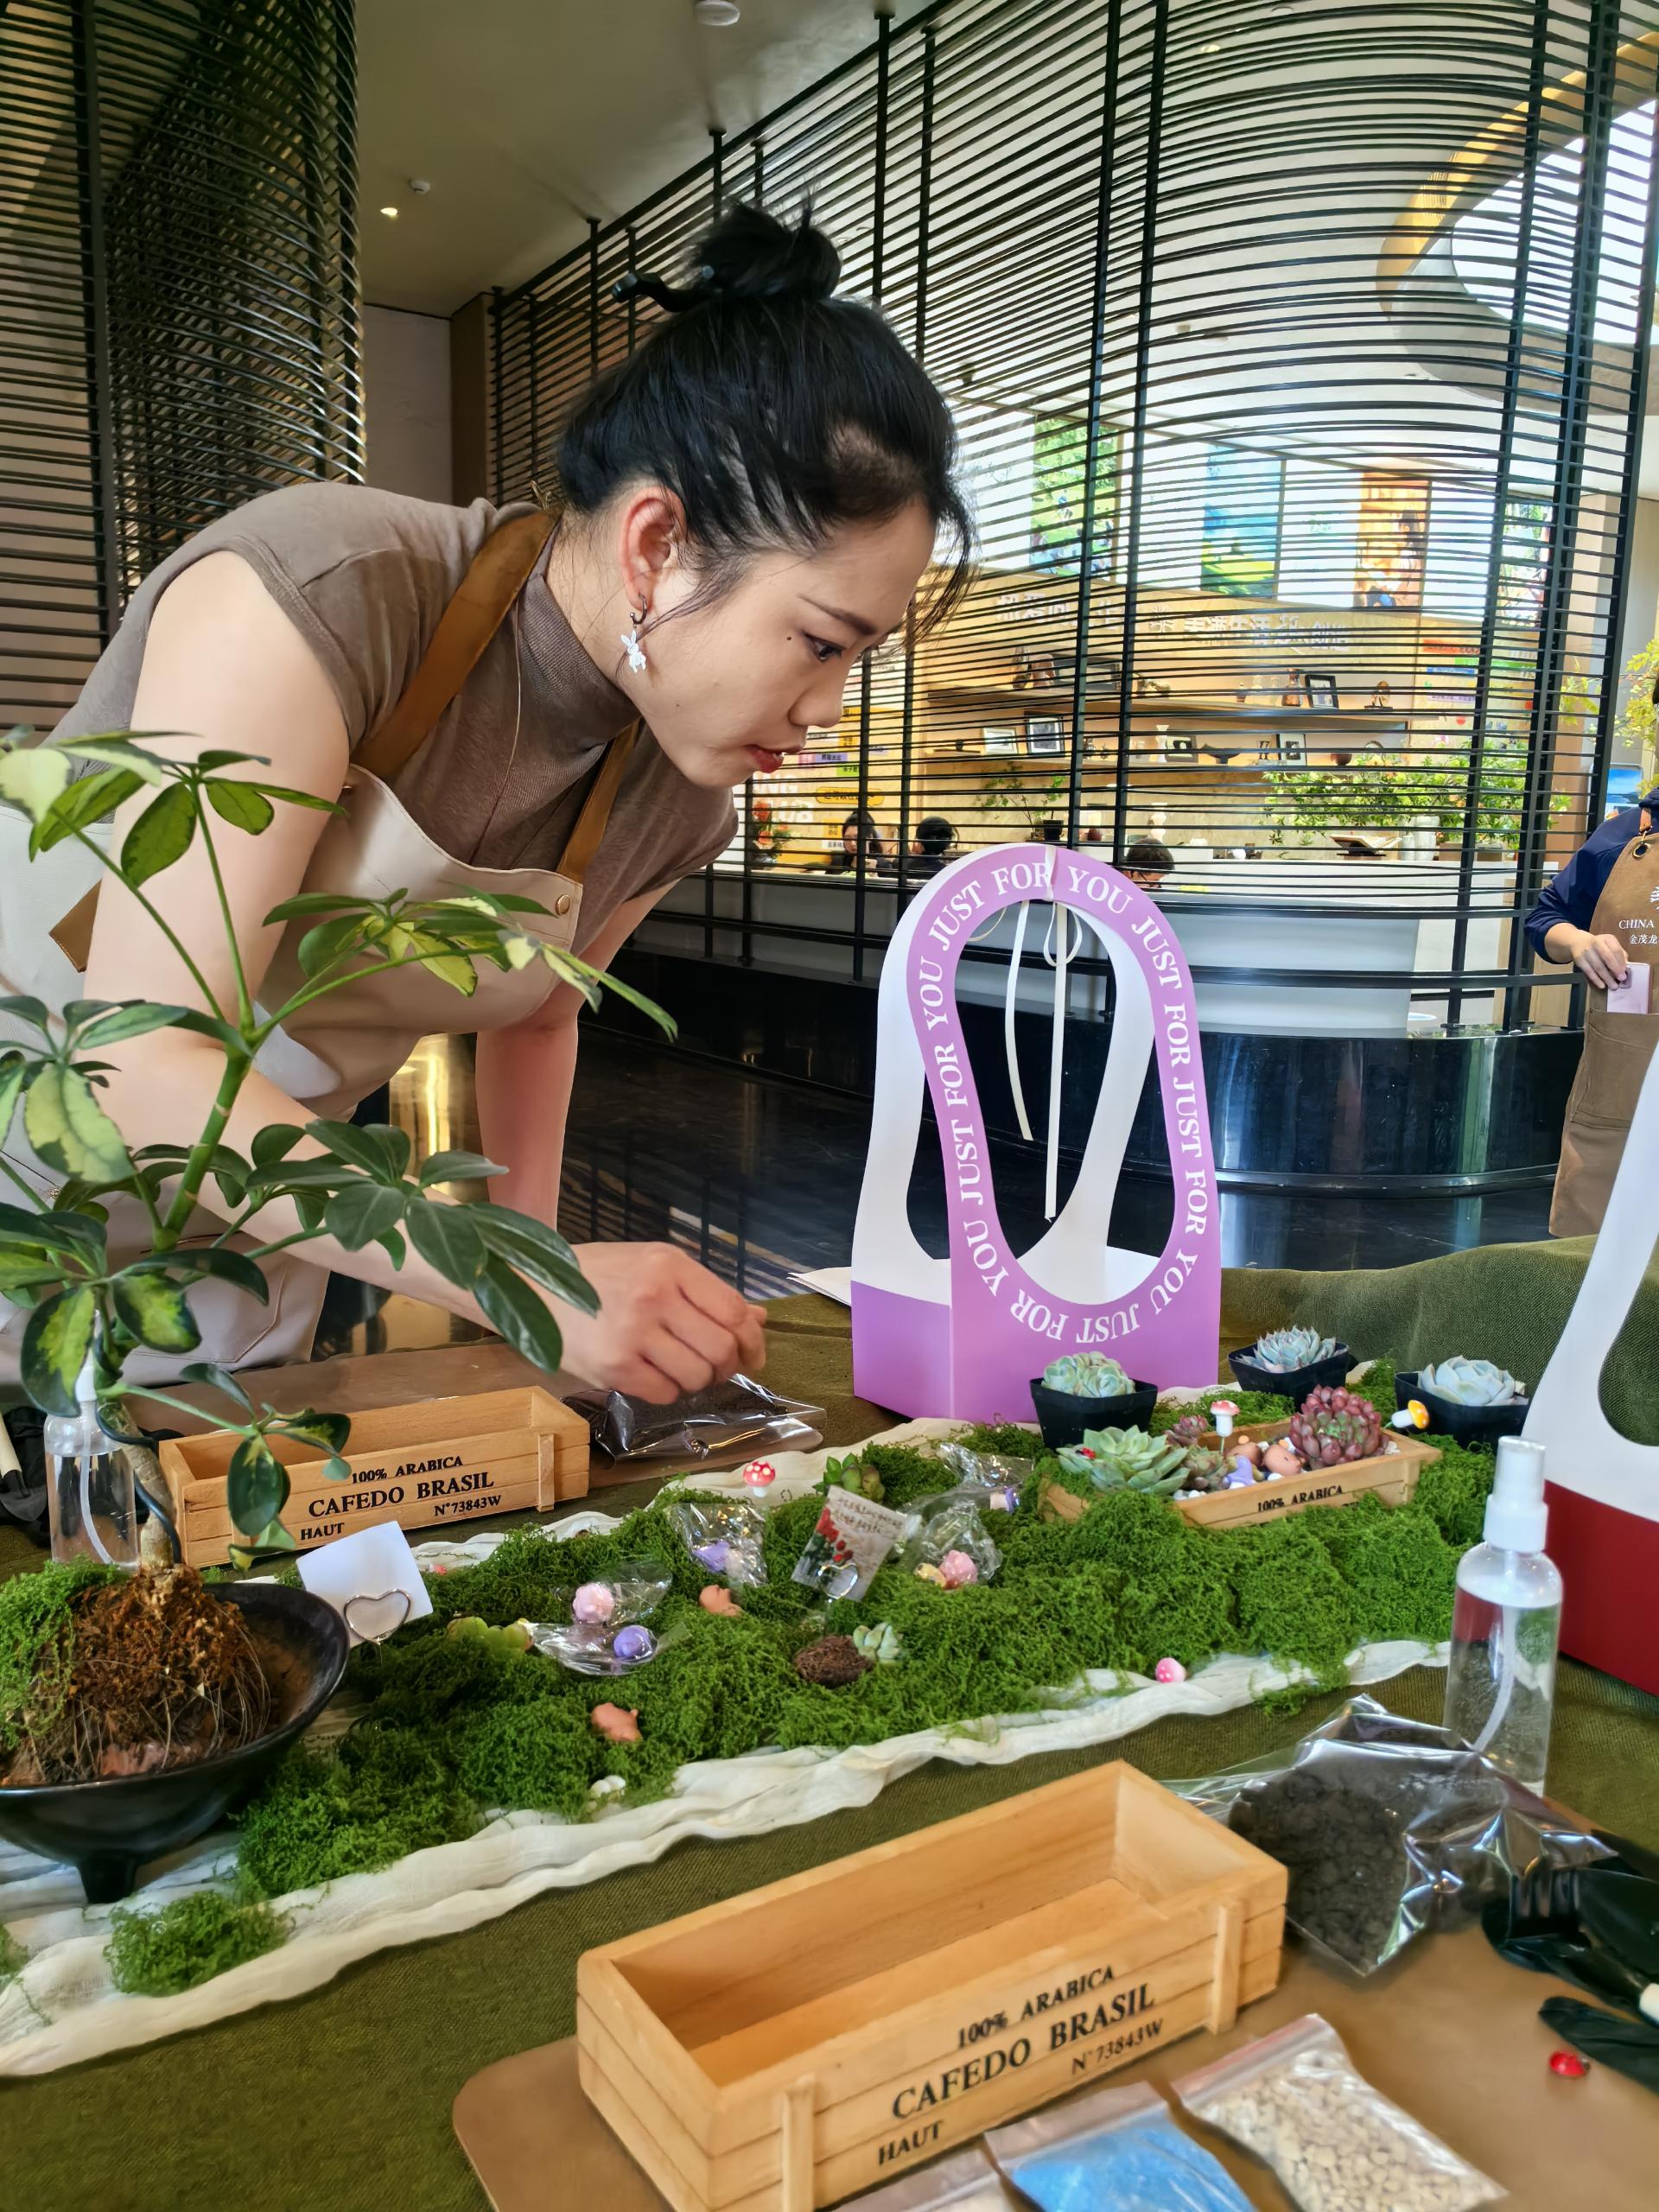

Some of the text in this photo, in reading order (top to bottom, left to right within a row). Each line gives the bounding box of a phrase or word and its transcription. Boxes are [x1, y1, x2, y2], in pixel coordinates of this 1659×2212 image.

[1618, 919, 1655, 930] CHINA
[1630, 934, 1659, 945] 金茂龙
[918, 862, 1209, 1344] JUST FOR YOU JUST FOR JUST FOR YOU JUST FOR YOU JUST FOR YOU
[352, 1456, 464, 1484] 100% ARABICA
[308, 1472, 495, 1517] CAFEDO BRASIL
[1257, 1485, 1344, 1513] 100% ARABICA
[300, 1522, 346, 1541] HAUT
[958, 1965, 1115, 2050] 100% ARABICA
[892, 1983, 1155, 2119] CAFEDO BRASIL
[878, 2120, 943, 2165] HAUT
